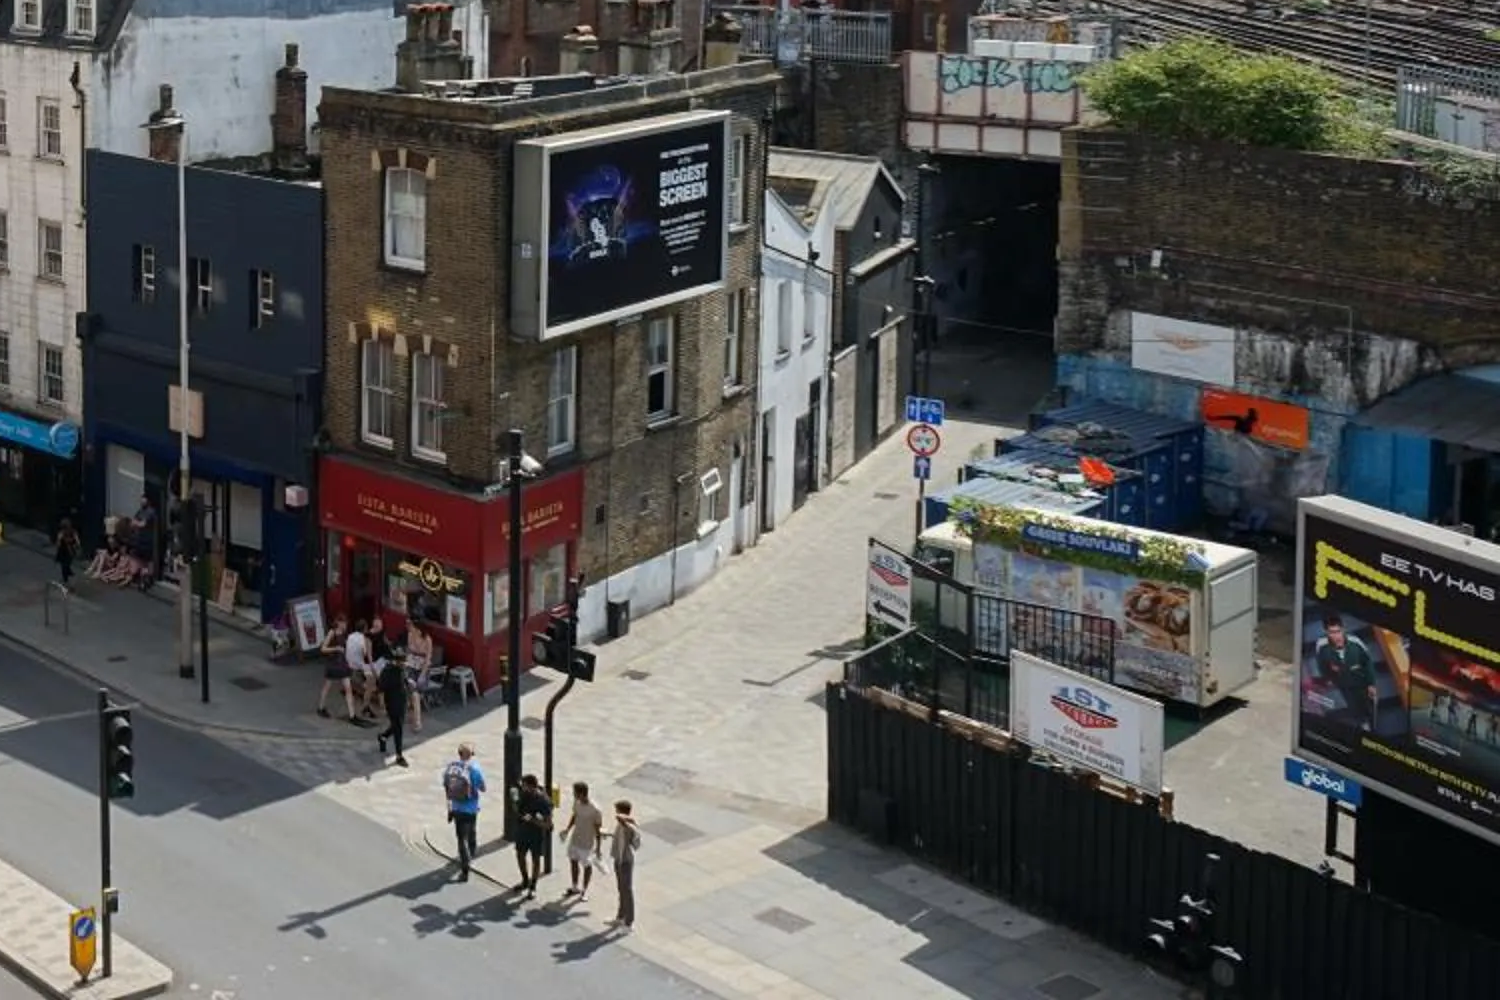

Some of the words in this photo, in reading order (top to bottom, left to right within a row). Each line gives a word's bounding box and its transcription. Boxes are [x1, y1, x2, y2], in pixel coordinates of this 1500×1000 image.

[660, 162, 708, 188] BIGGEST
[660, 180, 708, 207] SCREEN
[1381, 552, 1411, 574] EE
[1414, 563, 1443, 583] TV
[1057, 685, 1113, 713] 1ST
[1301, 767, 1346, 793] global
